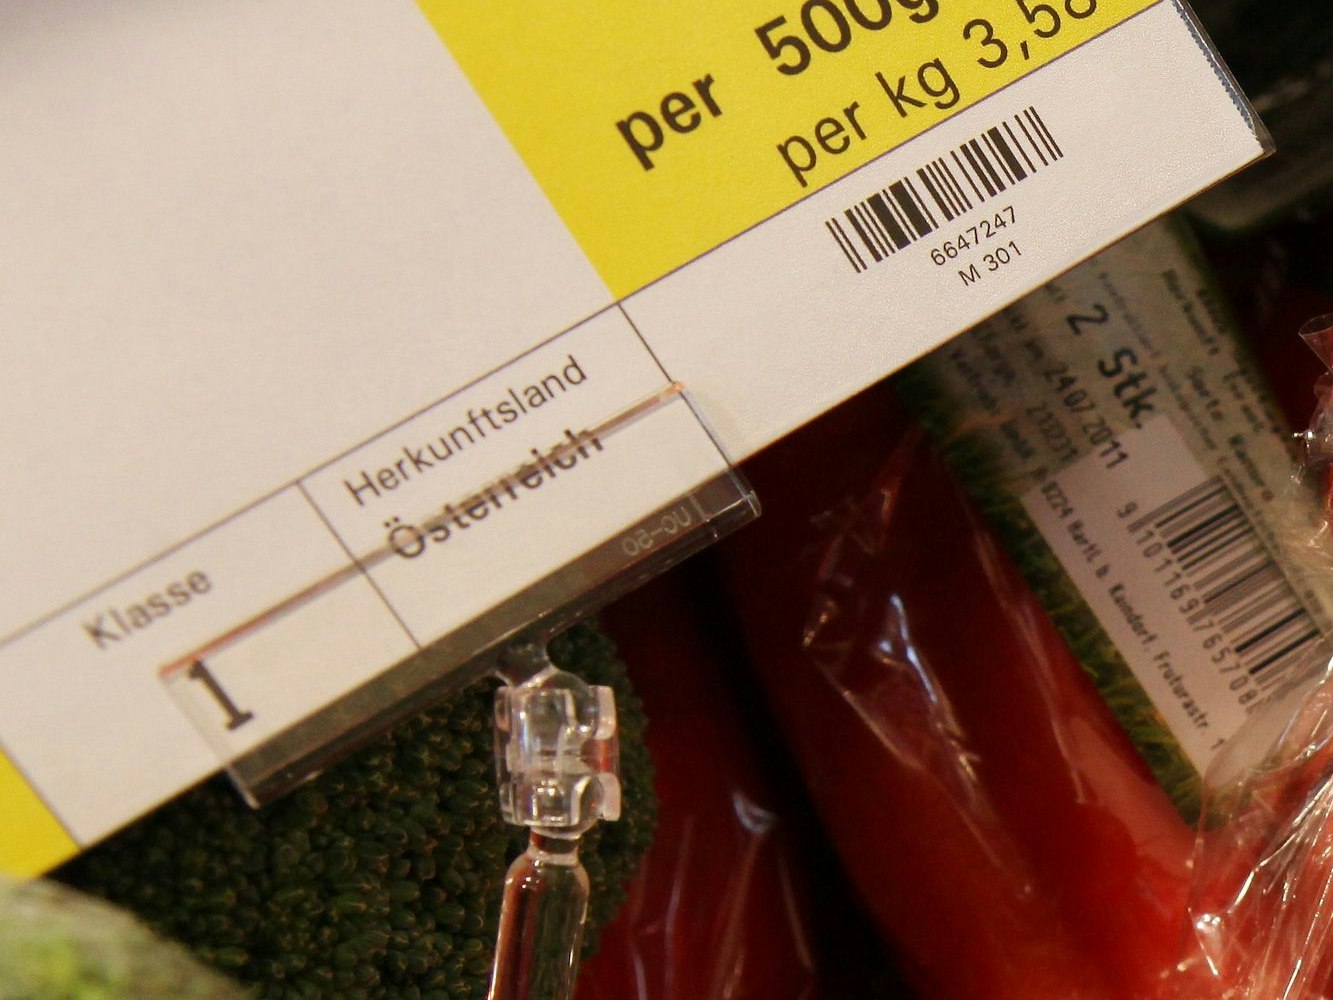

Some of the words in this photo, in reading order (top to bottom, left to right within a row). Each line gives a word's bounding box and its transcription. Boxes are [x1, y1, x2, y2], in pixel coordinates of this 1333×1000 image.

[616, 73, 722, 171] per
[777, 101, 867, 187] per
[875, 57, 961, 114] kg
[930, 206, 1017, 267] 6647247
[958, 267, 981, 287] M
[984, 240, 1022, 272] 301
[1066, 304, 1109, 335] 2
[1097, 347, 1158, 429] Stk.
[343, 355, 588, 507] Herkunftsland
[384, 427, 604, 560] Österreich
[1116, 501, 1138, 519] 9
[80, 569, 213, 650] Klasse
